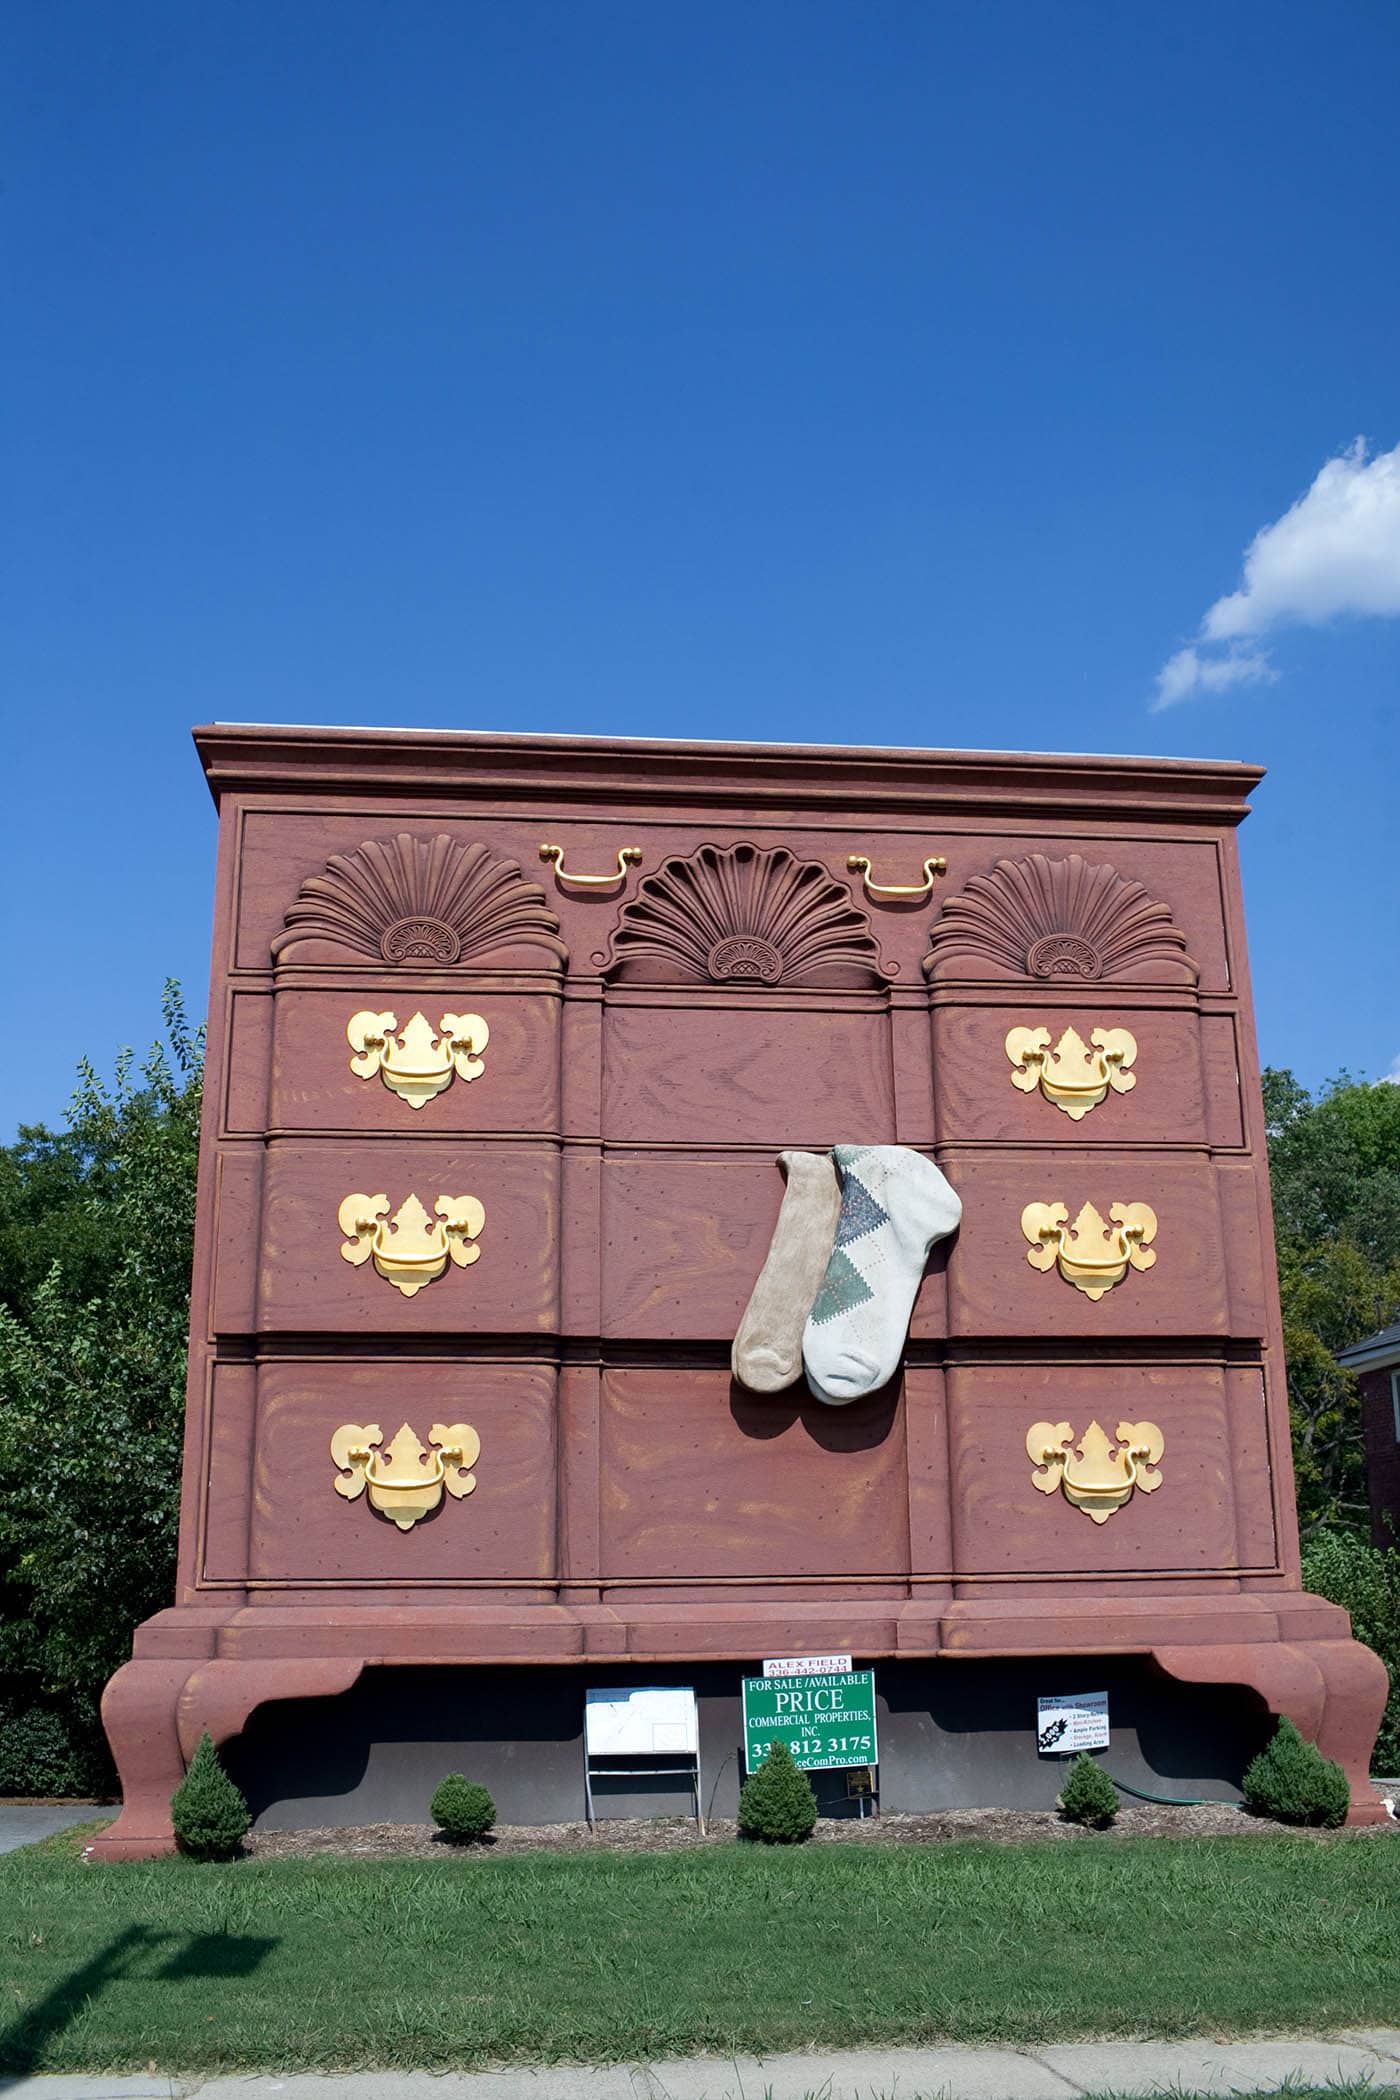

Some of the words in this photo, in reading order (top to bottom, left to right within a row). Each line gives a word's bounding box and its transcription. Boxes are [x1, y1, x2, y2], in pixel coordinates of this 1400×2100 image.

[768, 1660, 804, 1669] ALEX
[808, 1658, 848, 1667] FIELD
[749, 1680, 772, 1691] FOR
[774, 1678, 802, 1690] SALE
[804, 1674, 869, 1688] /AVAILABLE
[775, 1689, 844, 1713] PRICE
[749, 1714, 810, 1728] COMMERCIAL
[801, 1726, 820, 1737] INC.
[790, 1740, 822, 1754] 812
[827, 1736, 871, 1752] 3175
